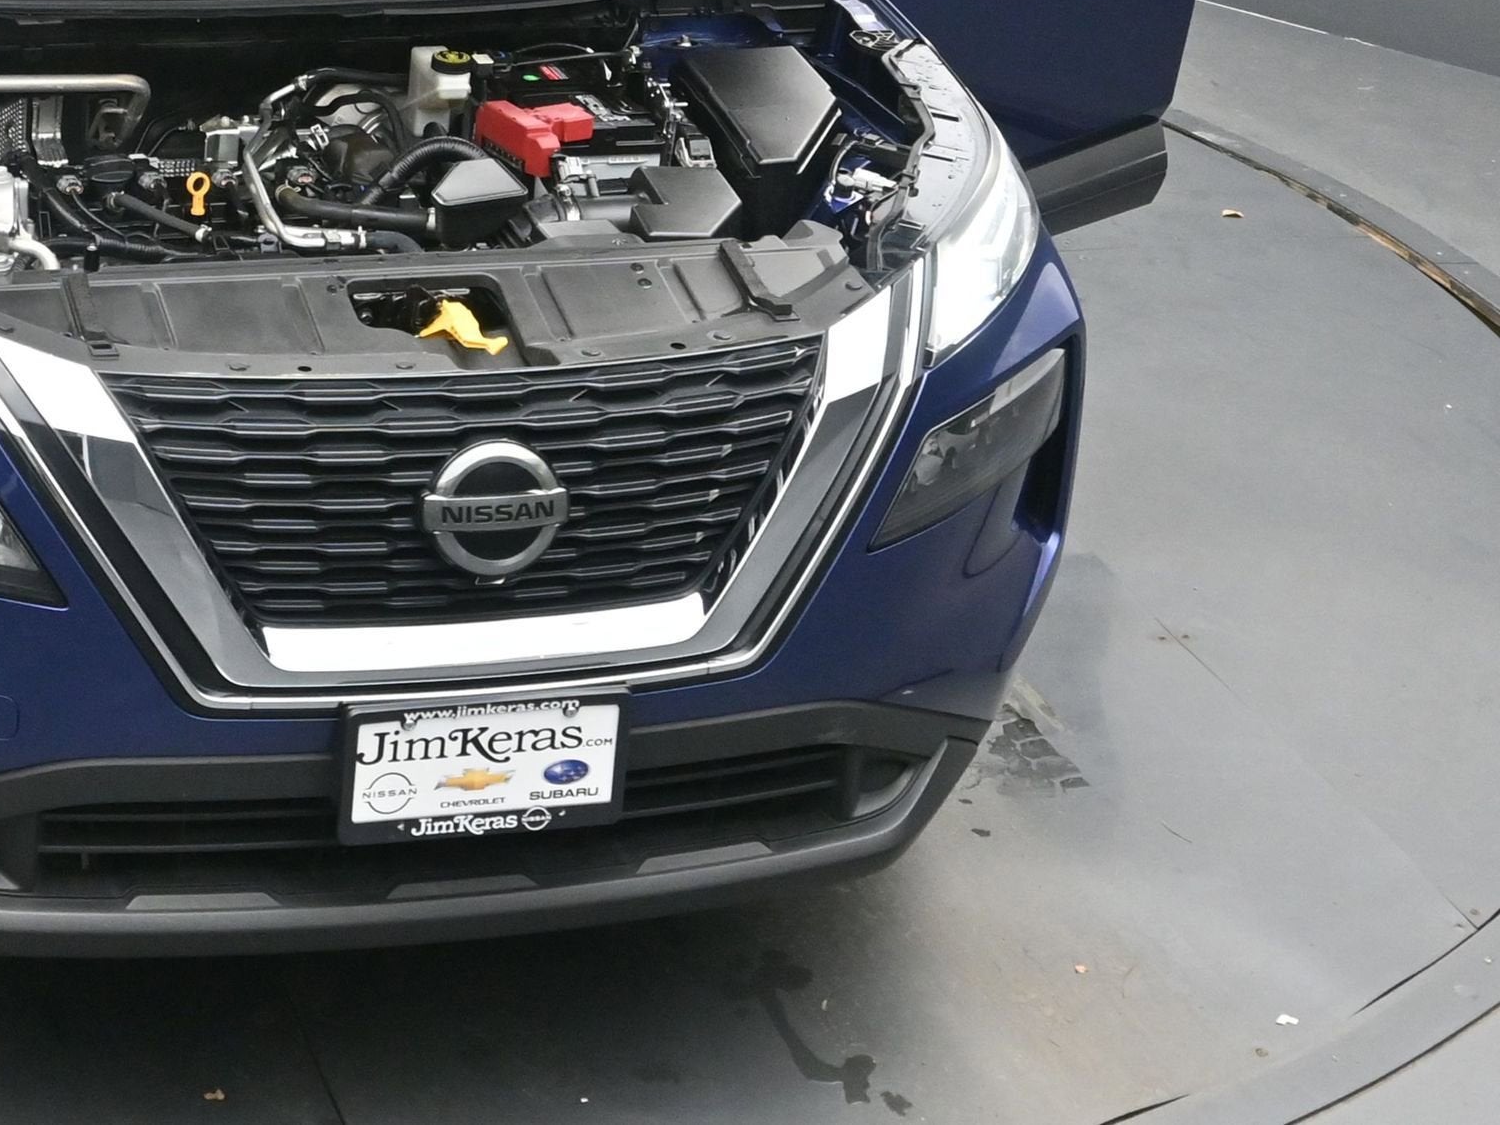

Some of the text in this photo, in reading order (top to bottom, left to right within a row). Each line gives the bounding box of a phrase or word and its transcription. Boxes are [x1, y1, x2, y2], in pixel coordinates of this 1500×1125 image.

[441, 500, 555, 524] NISSAN
[404, 700, 580, 720] www.jimkeras.com
[362, 787, 418, 799] NISSAN
[529, 787, 599, 801] SUBARU
[440, 797, 505, 808] CHEVROLET
[411, 815, 518, 836] JimKeras
